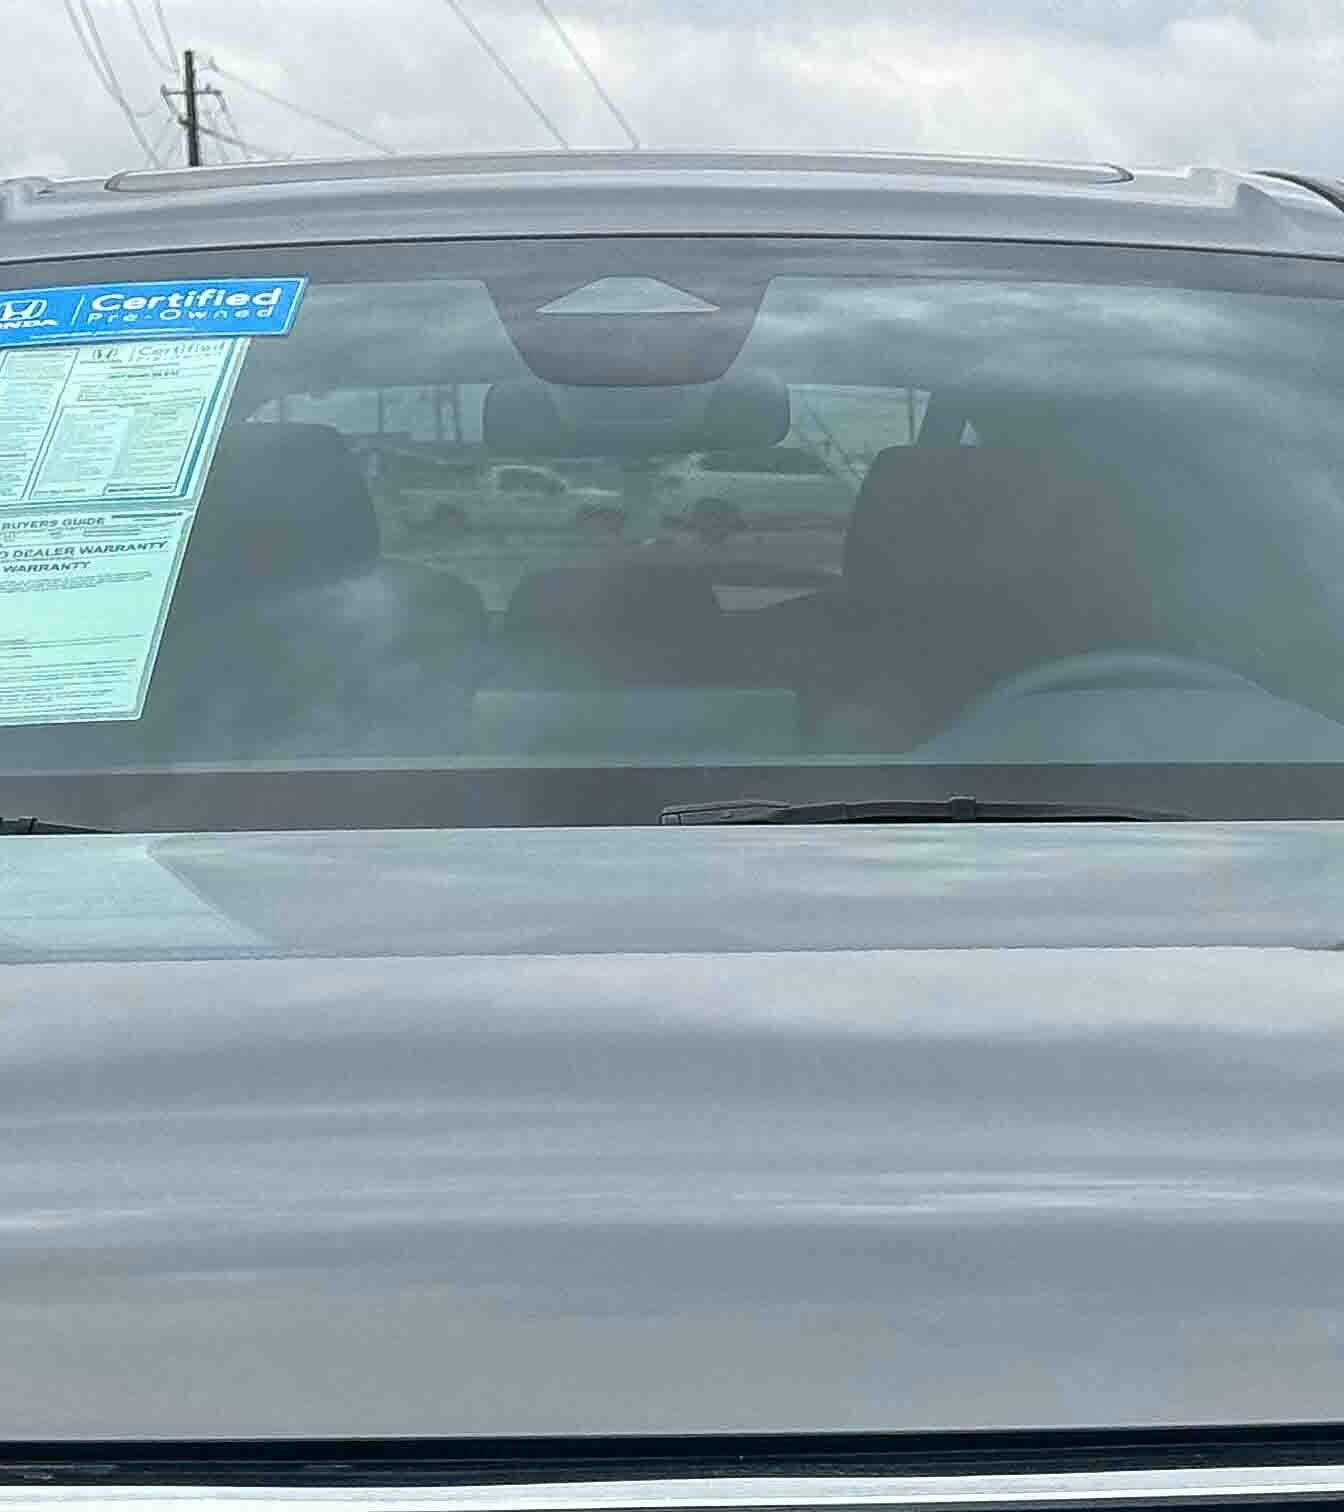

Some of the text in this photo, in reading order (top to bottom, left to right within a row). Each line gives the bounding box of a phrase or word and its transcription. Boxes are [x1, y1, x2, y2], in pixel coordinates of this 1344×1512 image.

[92, 287, 282, 312] Certified
[88, 307, 273, 323] Pre-Owned
[1, 517, 106, 531] BUYERS GUIDE
[13, 547, 75, 559] DEALER
[79, 540, 169, 555] WARRANTY
[4, 561, 90, 574] WARRANTY
